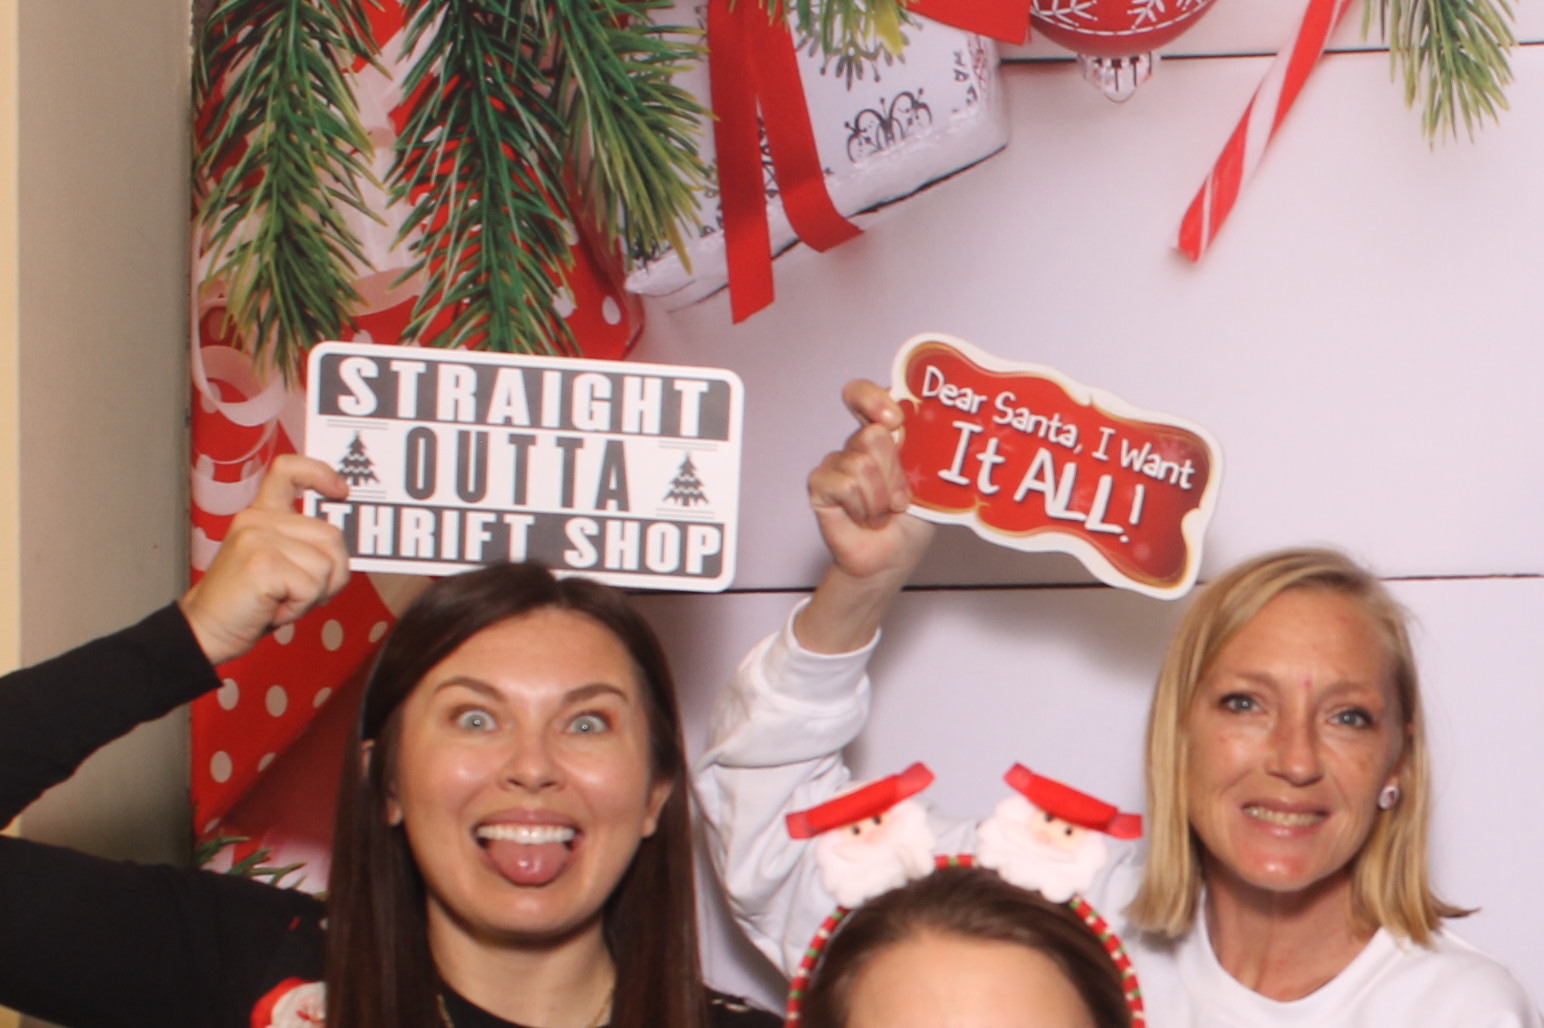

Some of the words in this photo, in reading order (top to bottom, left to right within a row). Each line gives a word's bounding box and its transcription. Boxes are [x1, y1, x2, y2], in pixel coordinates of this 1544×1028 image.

[337, 356, 709, 437] STRAIGHT
[921, 365, 988, 414] Dear
[992, 391, 1084, 454] Santa,
[1092, 427, 1115, 461] I
[1119, 439, 1196, 489] Want
[404, 426, 630, 512] OUTTA
[937, 420, 1006, 494] It
[1012, 448, 1145, 543] ALL!
[320, 502, 535, 562] THRIFT
[564, 517, 722, 574] SHOP
